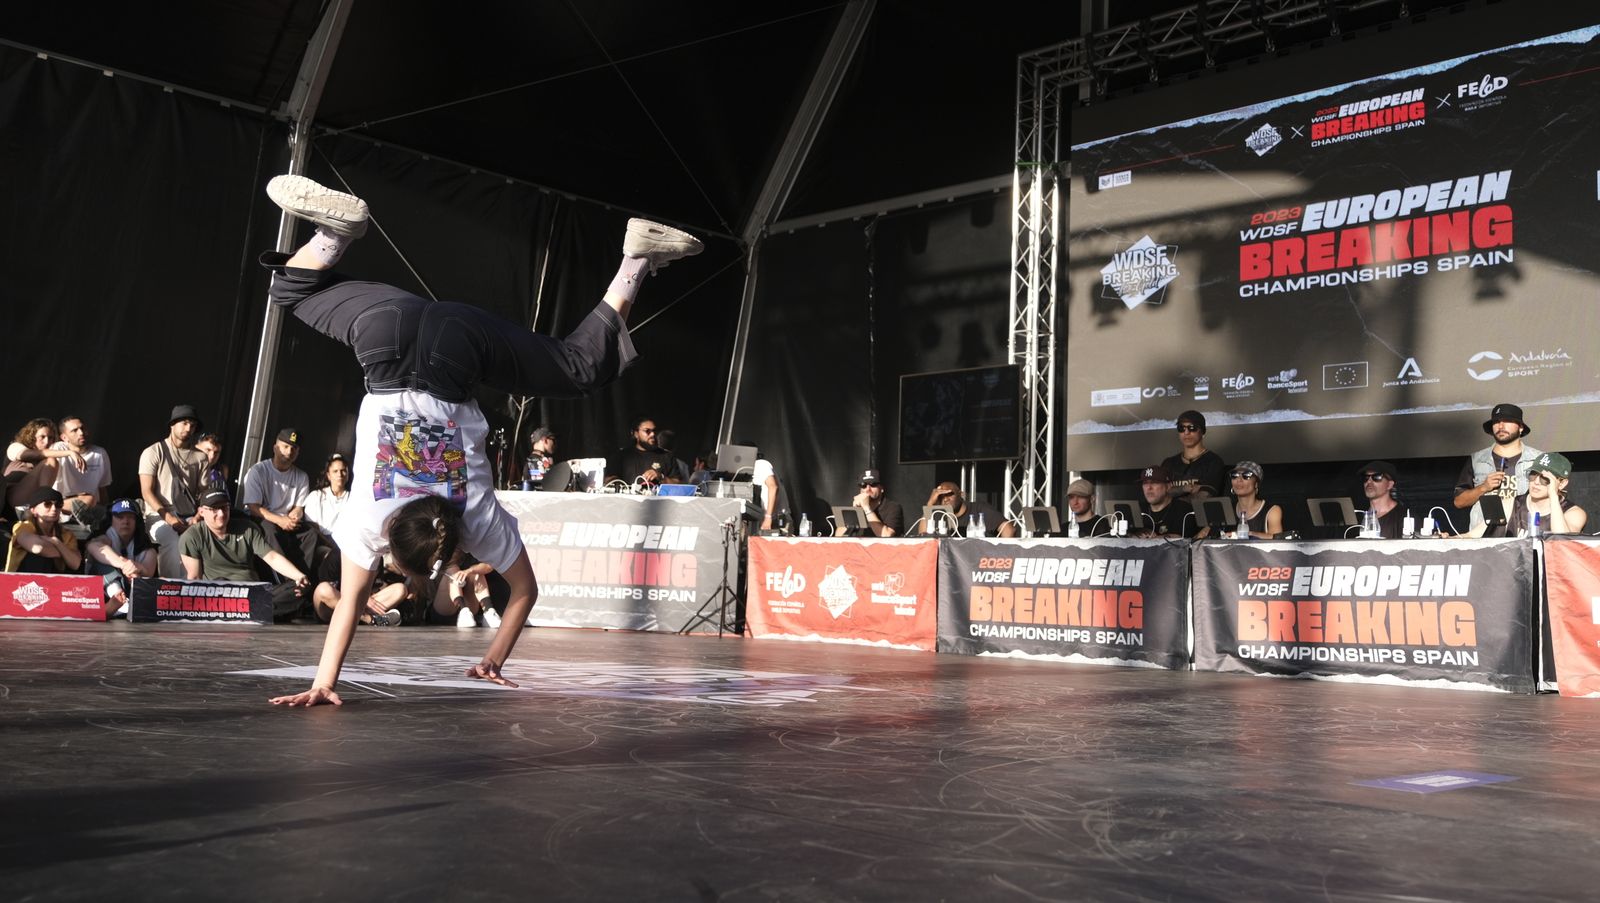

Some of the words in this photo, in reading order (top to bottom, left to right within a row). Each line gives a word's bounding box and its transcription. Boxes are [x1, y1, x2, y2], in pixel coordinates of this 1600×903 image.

[1311, 113, 1337, 123] WDSF
[1338, 88, 1425, 118] EUROPEAN
[1311, 102, 1425, 140] BREAKING
[1311, 127, 1392, 148] CHAMPIONSHIPS
[1394, 119, 1425, 131] SPAIN
[1240, 222, 1298, 242] WDSF
[1300, 169, 1512, 232] EUROPEAN
[1250, 206, 1302, 226] 2023
[1239, 204, 1513, 282] BREAKING
[1114, 245, 1168, 271] WDSF
[1102, 263, 1178, 286] BREAKING
[1239, 260, 1428, 298] CHAMPIONSHIPS
[1437, 249, 1514, 272] SPAIN
[1267, 380, 1308, 389] DanceSport
[1508, 369, 1540, 378] SPORT
[558, 522, 700, 550] EUROPEAN
[529, 548, 697, 588] REAKING
[972, 571, 1010, 583] WDSF
[1011, 557, 1145, 587] EUROPEAN
[979, 558, 1012, 569] 2023
[1247, 567, 1292, 580] 2023
[180, 585, 249, 598] EUROPEAN
[1238, 583, 1289, 596] WDSF
[1292, 564, 1473, 597] EUROPEAN
[61, 596, 100, 604] DanceSport
[156, 596, 250, 613] BREAKING
[538, 584, 643, 600] AMPIONSHIPS
[648, 589, 696, 603] SPAIN
[156, 610, 224, 618] CHAMPIONSHIPS
[226, 611, 250, 619] SPAIN
[969, 586, 1143, 629] BREAKING
[969, 623, 1091, 643] CHAMPIONSHIPS
[1095, 631, 1144, 646] SPAIN
[1237, 600, 1477, 647] BREAKING
[1237, 644, 1407, 664] CHAMPIONSHIPS
[1413, 650, 1479, 666] SPAIN
